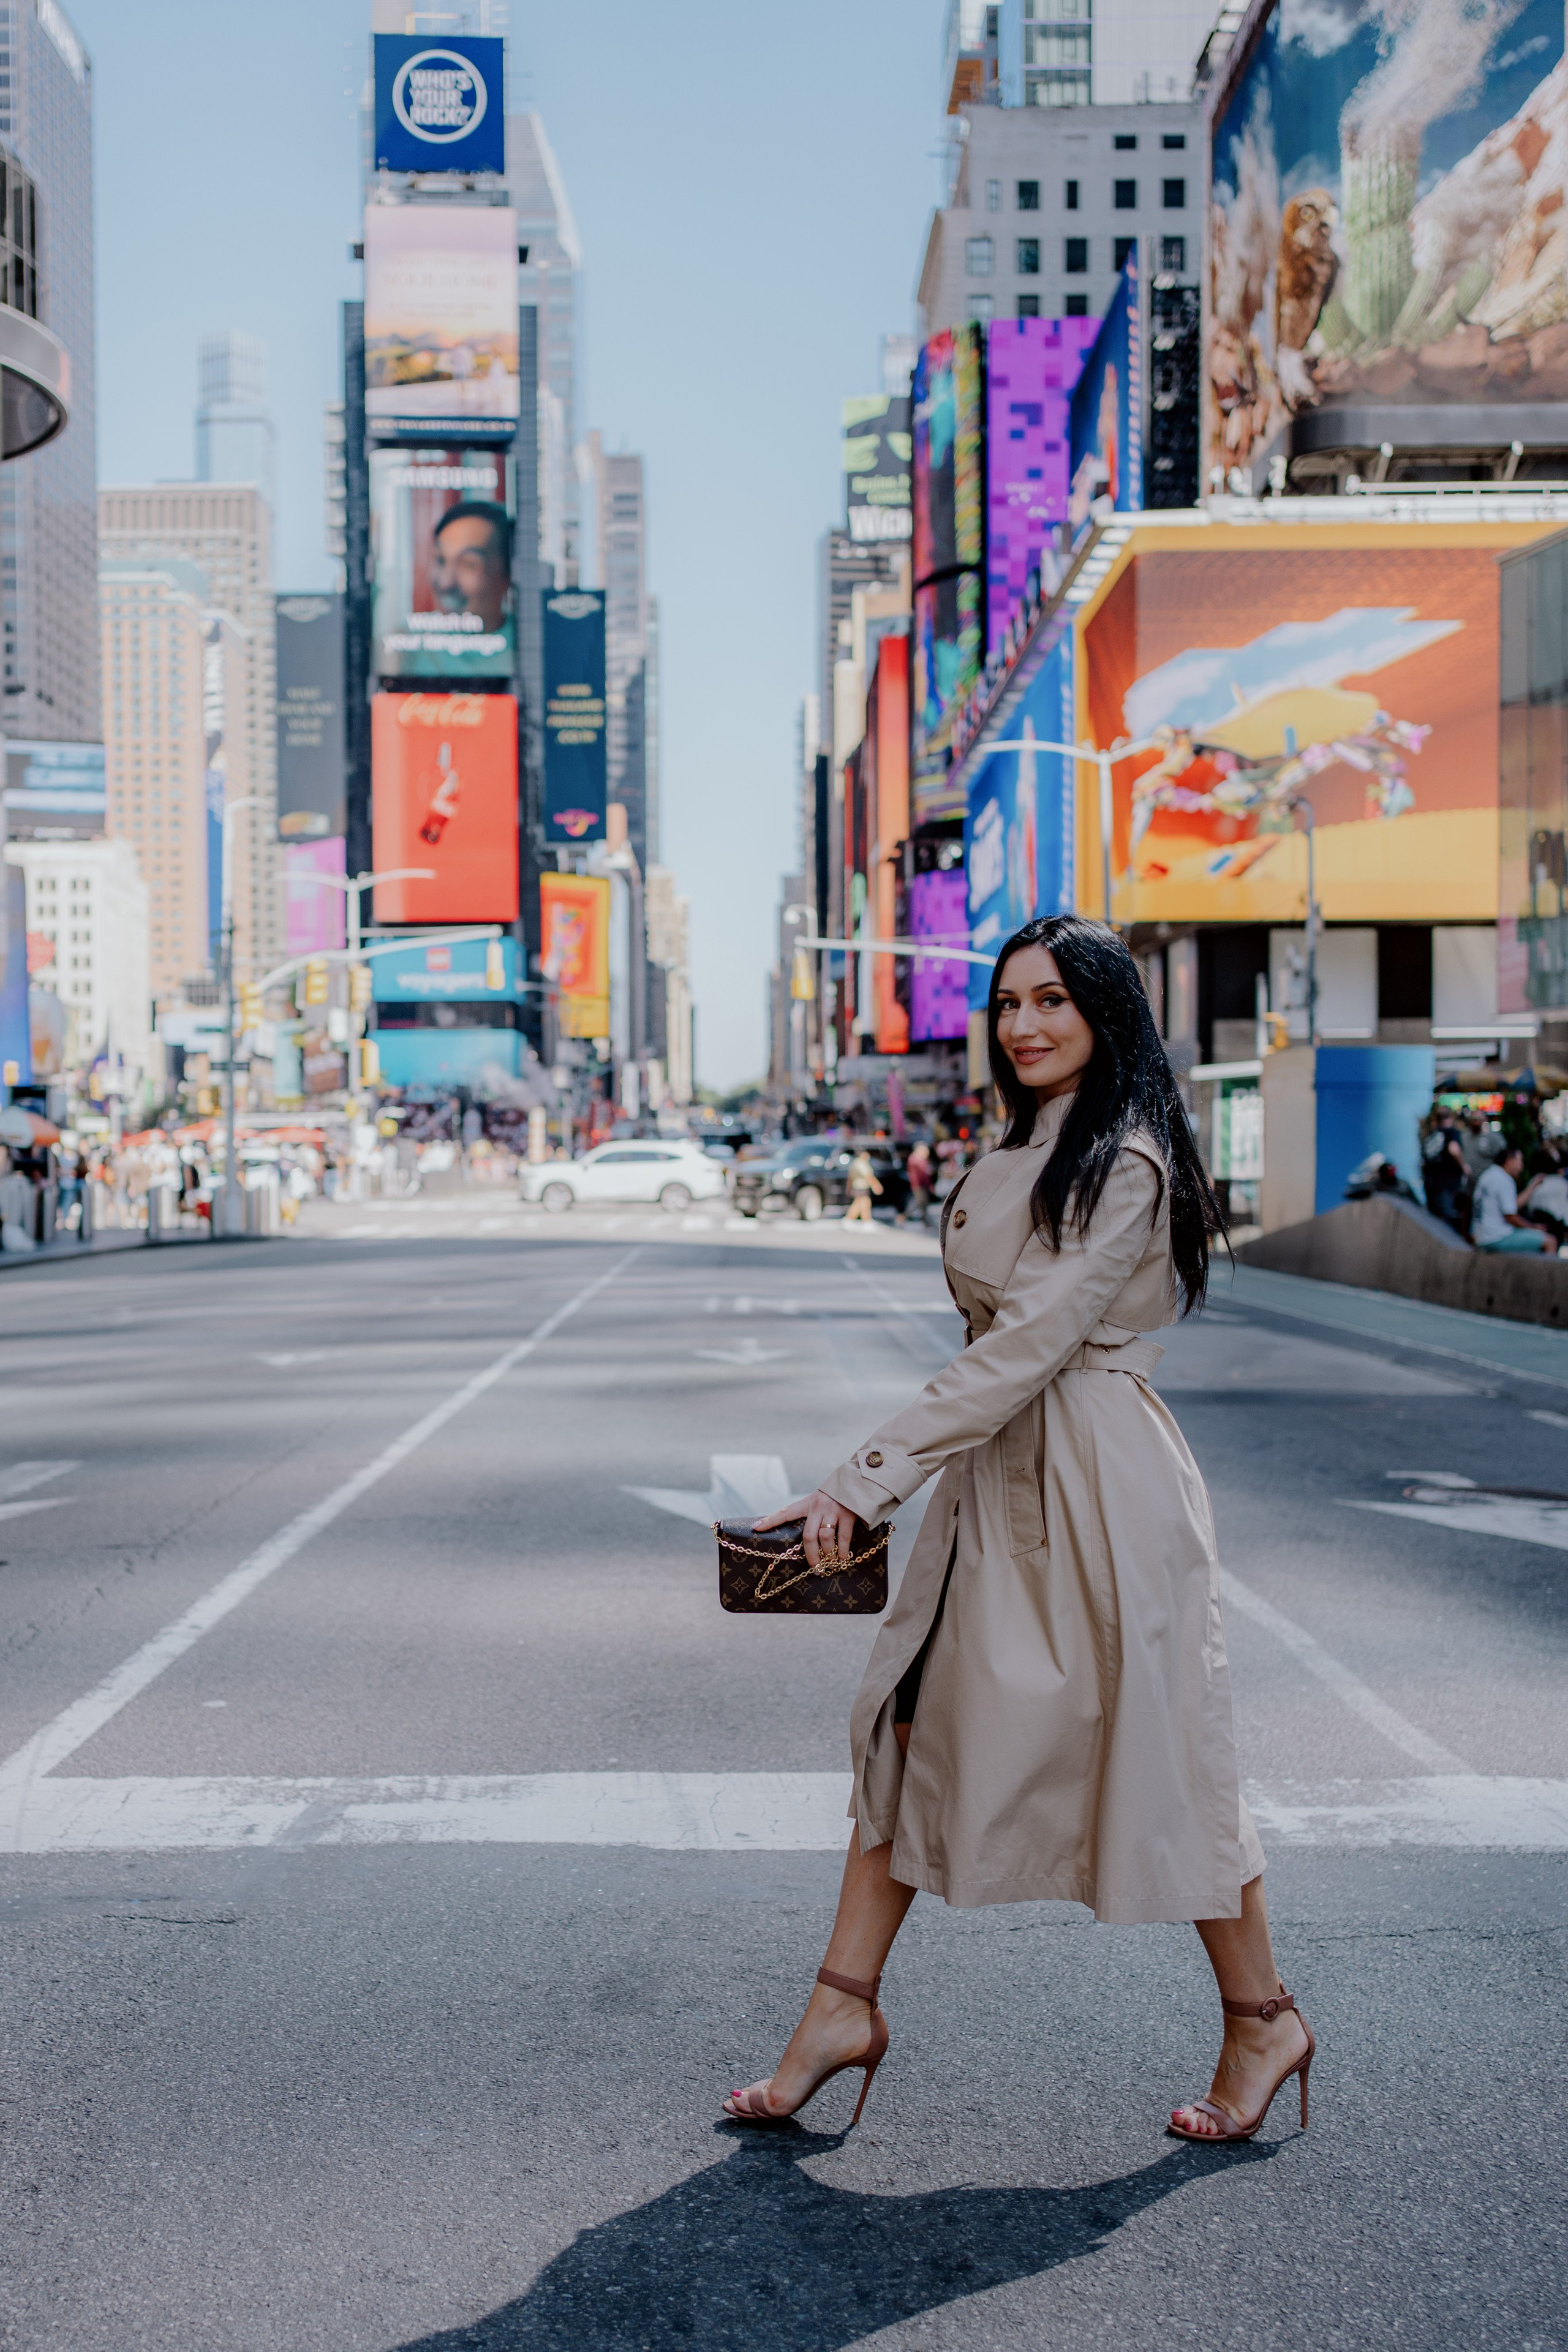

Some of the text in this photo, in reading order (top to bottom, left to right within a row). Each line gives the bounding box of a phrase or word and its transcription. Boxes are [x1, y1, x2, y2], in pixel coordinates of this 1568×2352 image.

[409, 88, 463, 106] YOUR
[389, 466, 499, 489] SAMSUNG
[382, 633, 507, 656] your language
